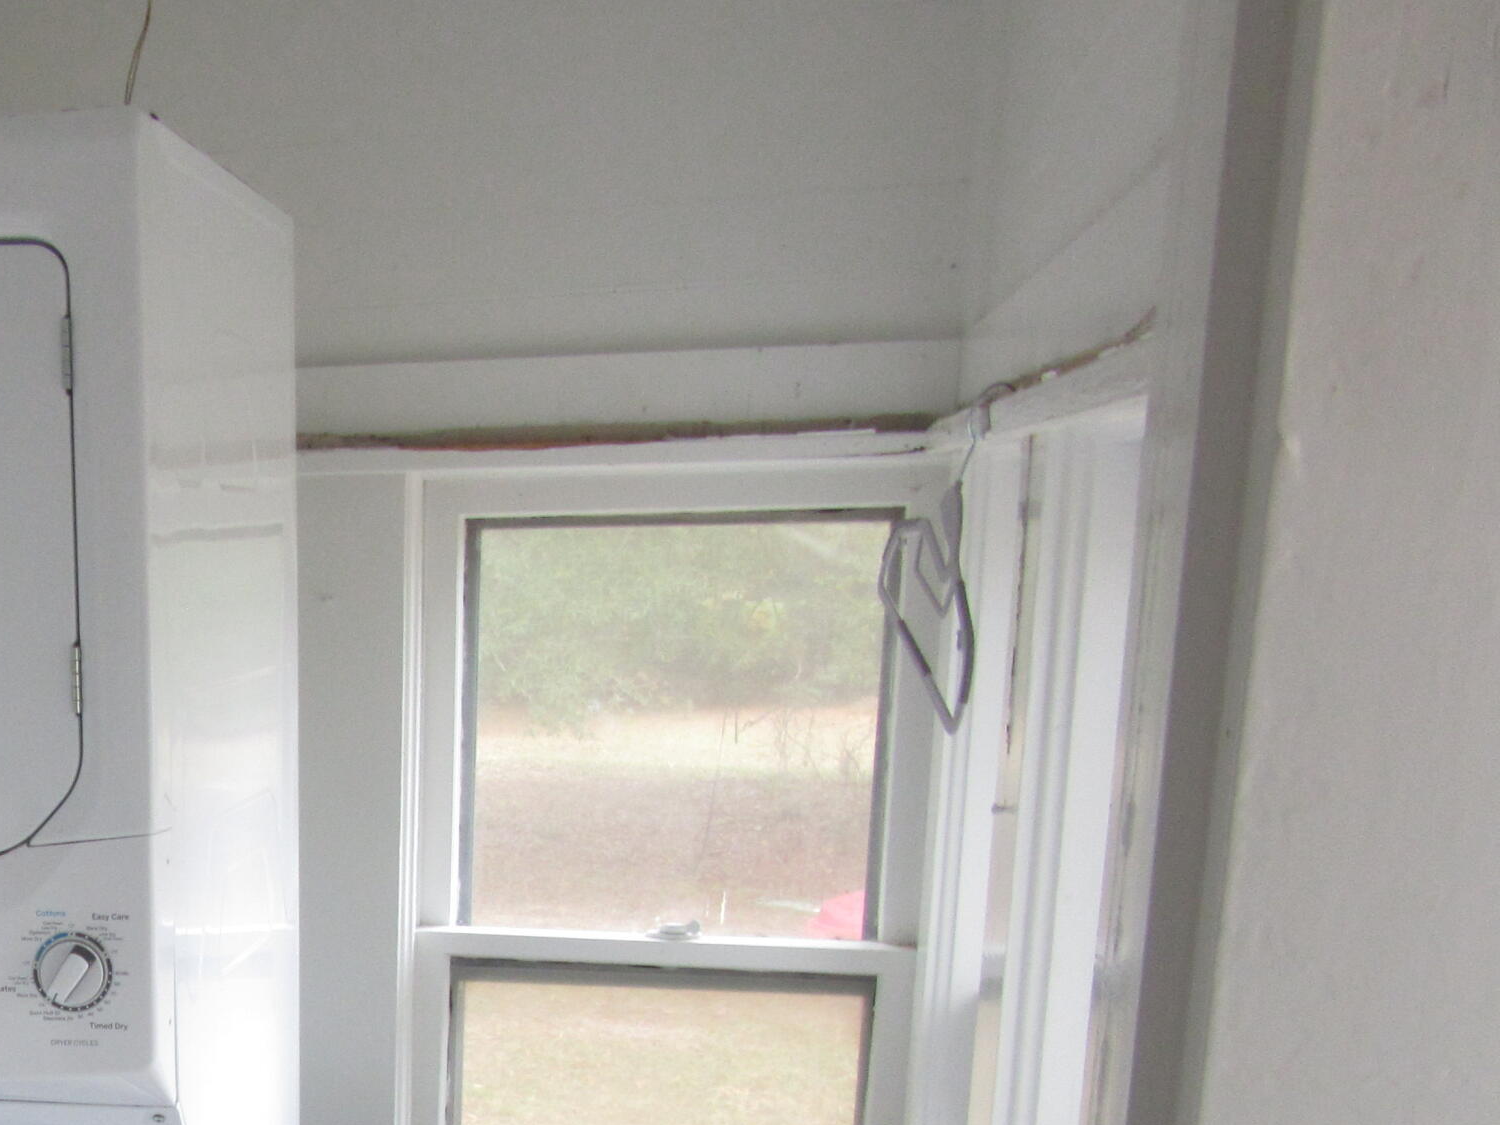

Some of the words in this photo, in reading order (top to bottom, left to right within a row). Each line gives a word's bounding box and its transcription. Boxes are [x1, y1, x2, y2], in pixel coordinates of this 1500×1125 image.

[91, 913, 110, 923] Easy
[111, 913, 130, 921] Care
[89, 1022, 113, 1030] Timed
[114, 1022, 128, 1031] Dry
